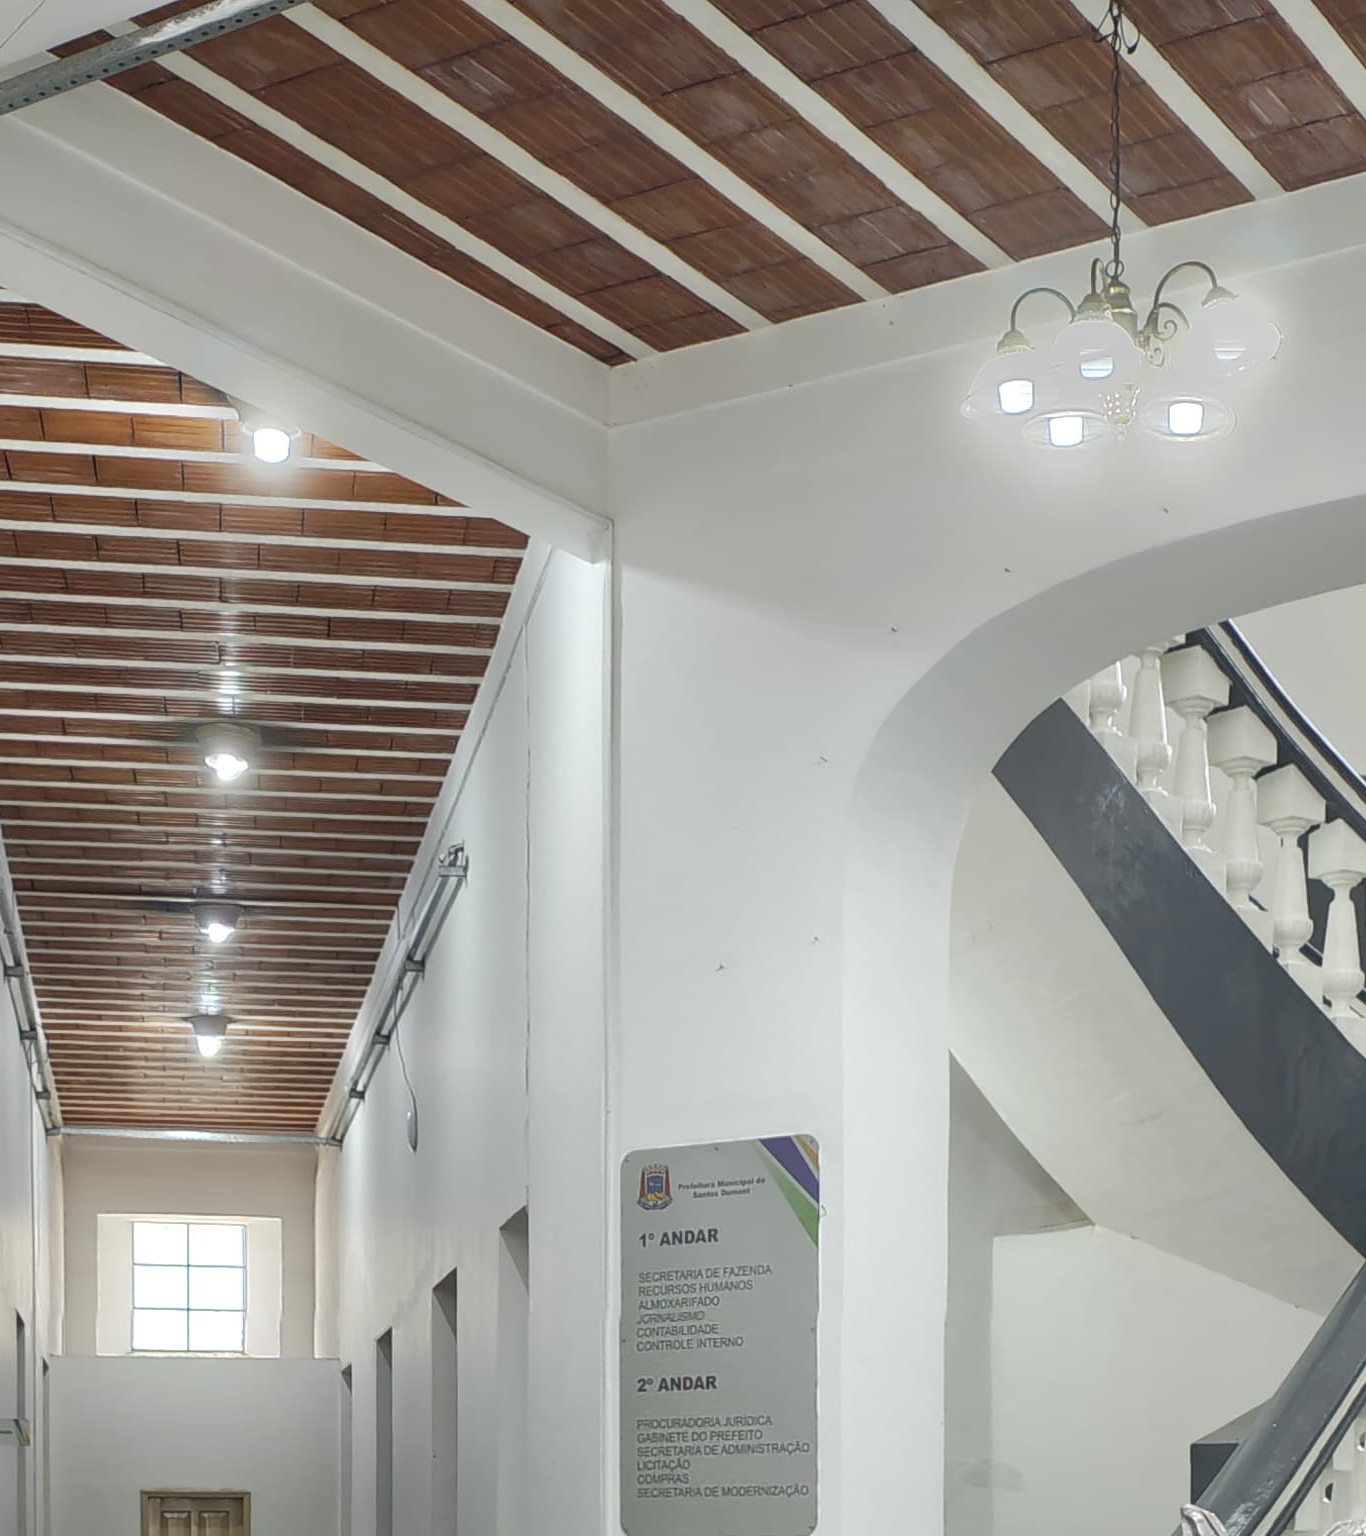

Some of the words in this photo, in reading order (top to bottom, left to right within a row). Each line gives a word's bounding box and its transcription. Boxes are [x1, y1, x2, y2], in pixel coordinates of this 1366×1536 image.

[677, 1181, 715, 1191] Prefeitura
[717, 1178, 754, 1189] Municipal
[692, 1189, 719, 1199] Santos
[720, 1187, 750, 1197] Dumont
[659, 1228, 719, 1247] ANDAR
[638, 1270, 703, 1283] SECRETARIA
[705, 1267, 721, 1279] DE
[722, 1264, 772, 1277] FAZENDA
[638, 1283, 697, 1297] RECURSOS
[699, 1280, 753, 1294] HUMANOS
[638, 1296, 721, 1310] ALMOXARIFADO
[636, 1324, 719, 1338] CONTABILIDADE
[636, 1338, 693, 1352] CONTROLE
[696, 1336, 744, 1349] INTERNO
[657, 1375, 717, 1392] ANDAR
[636, 1416, 721, 1430] PROCURADORIA
[723, 1413, 773, 1427] JURÍDICA
[637, 1431, 690, 1444] GABINETE
[691, 1431, 707, 1442] DO
[709, 1429, 763, 1441] PREFEITO
[636, 1444, 702, 1457] SECRETARIA
[703, 1444, 719, 1455] DE
[721, 1441, 811, 1455] ADMINISTRAÇÃO
[637, 1458, 691, 1472] LICITAÇÃO
[637, 1473, 689, 1485] COMPRAS
[636, 1487, 703, 1499] SECRETARIA
[704, 1486, 719, 1498] DE
[721, 1483, 809, 1498] MODERNIZAÇÃO
